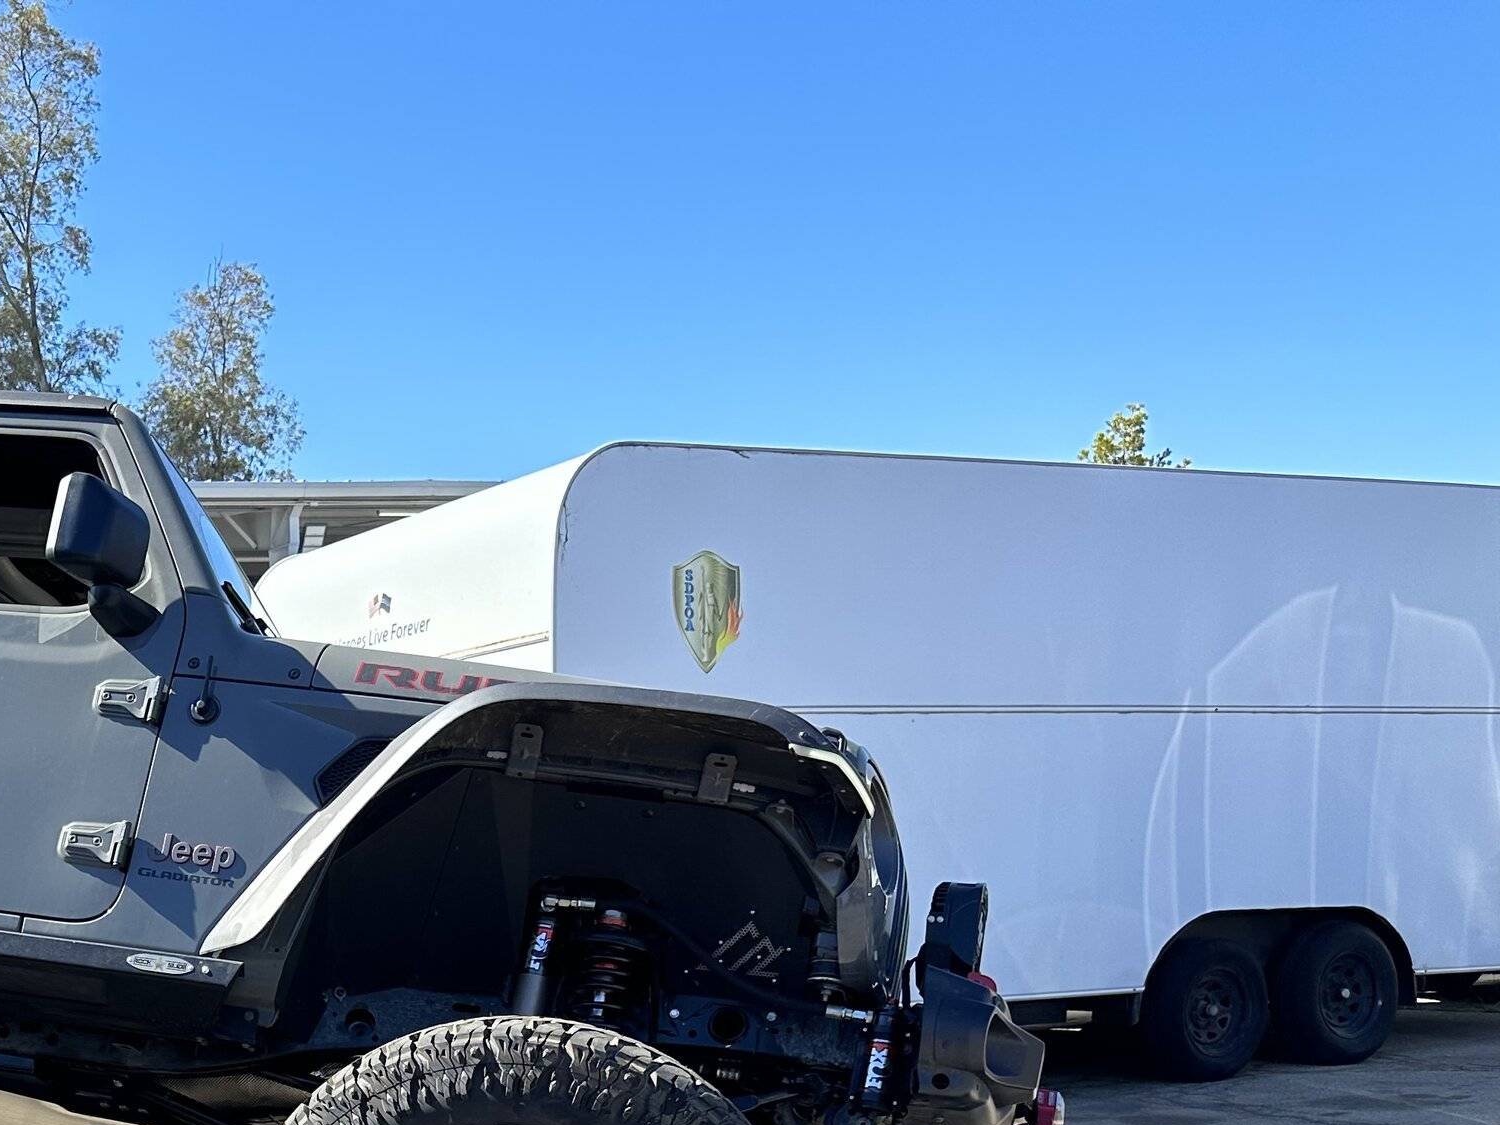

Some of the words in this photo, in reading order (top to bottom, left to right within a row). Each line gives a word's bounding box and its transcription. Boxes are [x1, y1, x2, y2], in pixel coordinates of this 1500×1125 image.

[684, 569, 695, 632] SDPOA
[368, 628, 389, 646] Live
[391, 618, 431, 640] Forever
[354, 660, 516, 694] RU
[148, 833, 236, 874] Jeep
[137, 866, 235, 888] GLADIATOR
[864, 1047, 891, 1089] FOX
